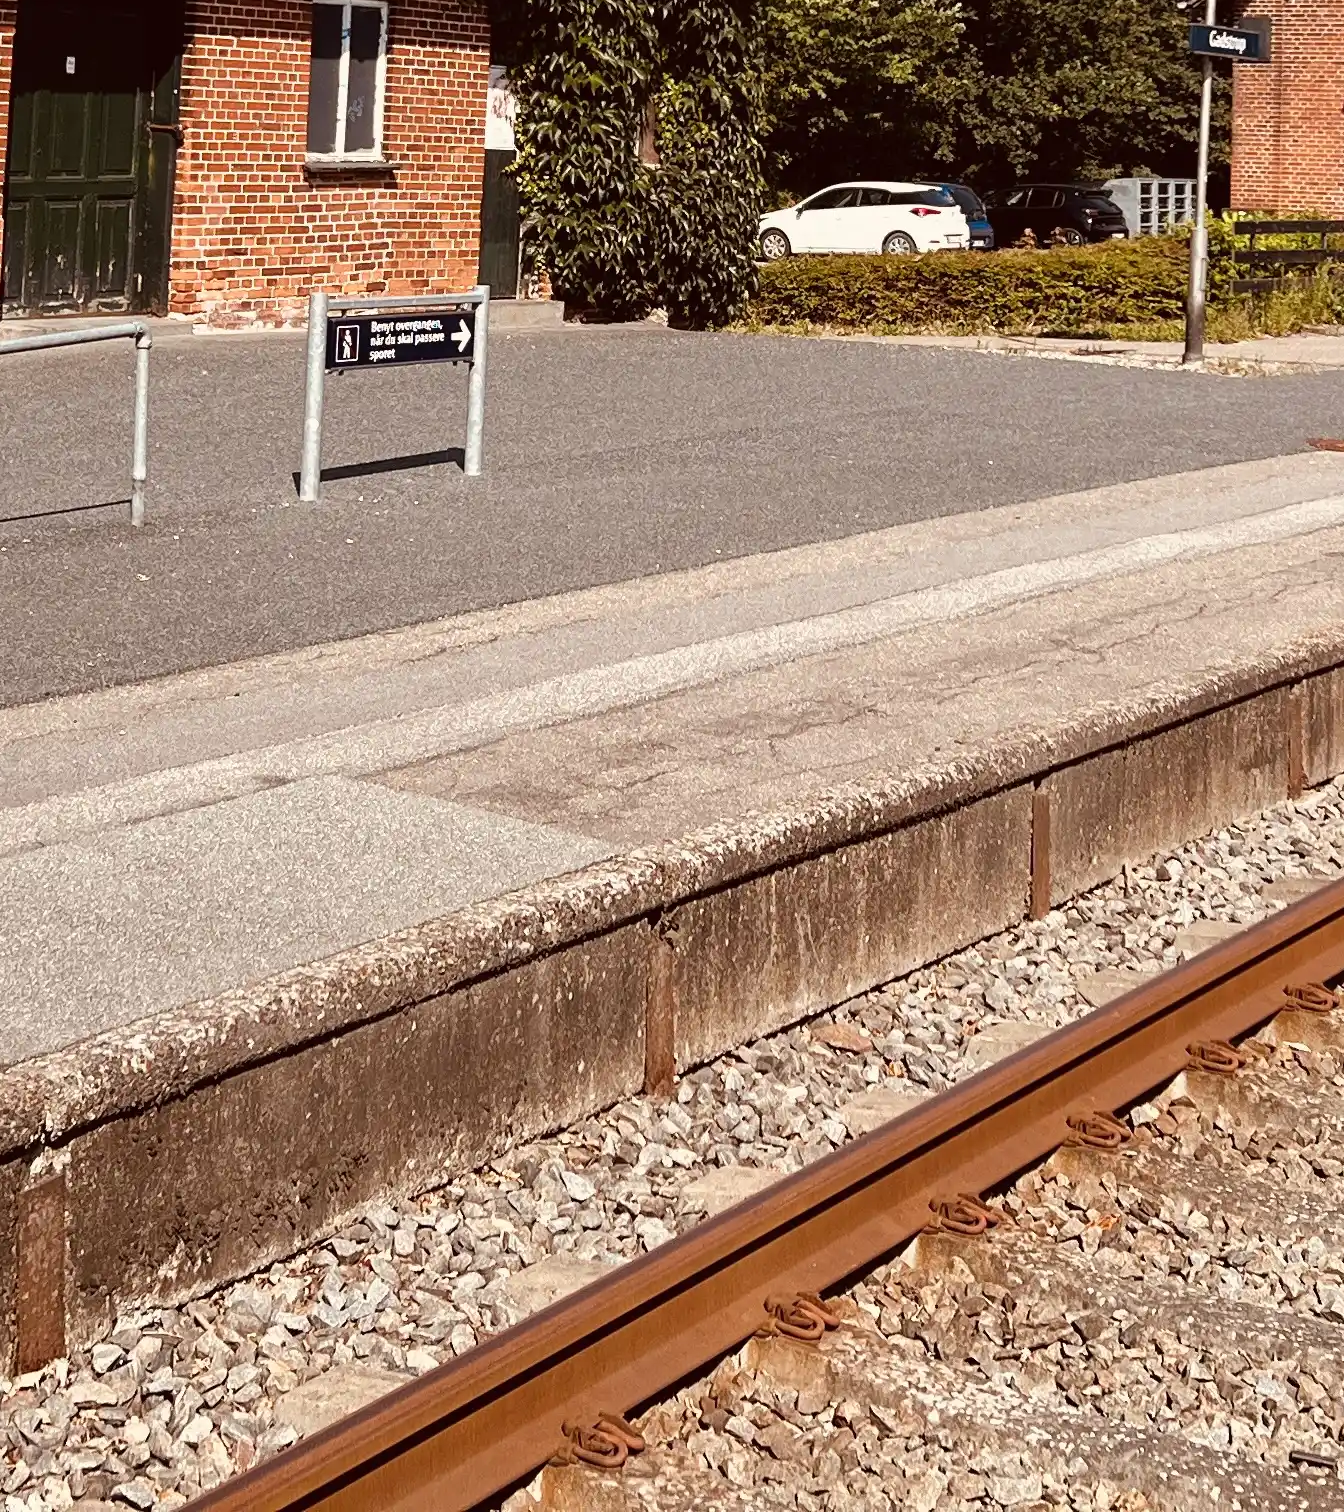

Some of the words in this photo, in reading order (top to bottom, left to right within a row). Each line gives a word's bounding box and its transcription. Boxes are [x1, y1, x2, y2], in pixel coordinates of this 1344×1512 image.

[370, 321, 395, 334] Benyt
[385, 334, 396, 345] du
[397, 332, 414, 344] skal
[415, 333, 445, 346] passere
[369, 348, 396, 362] sporet
